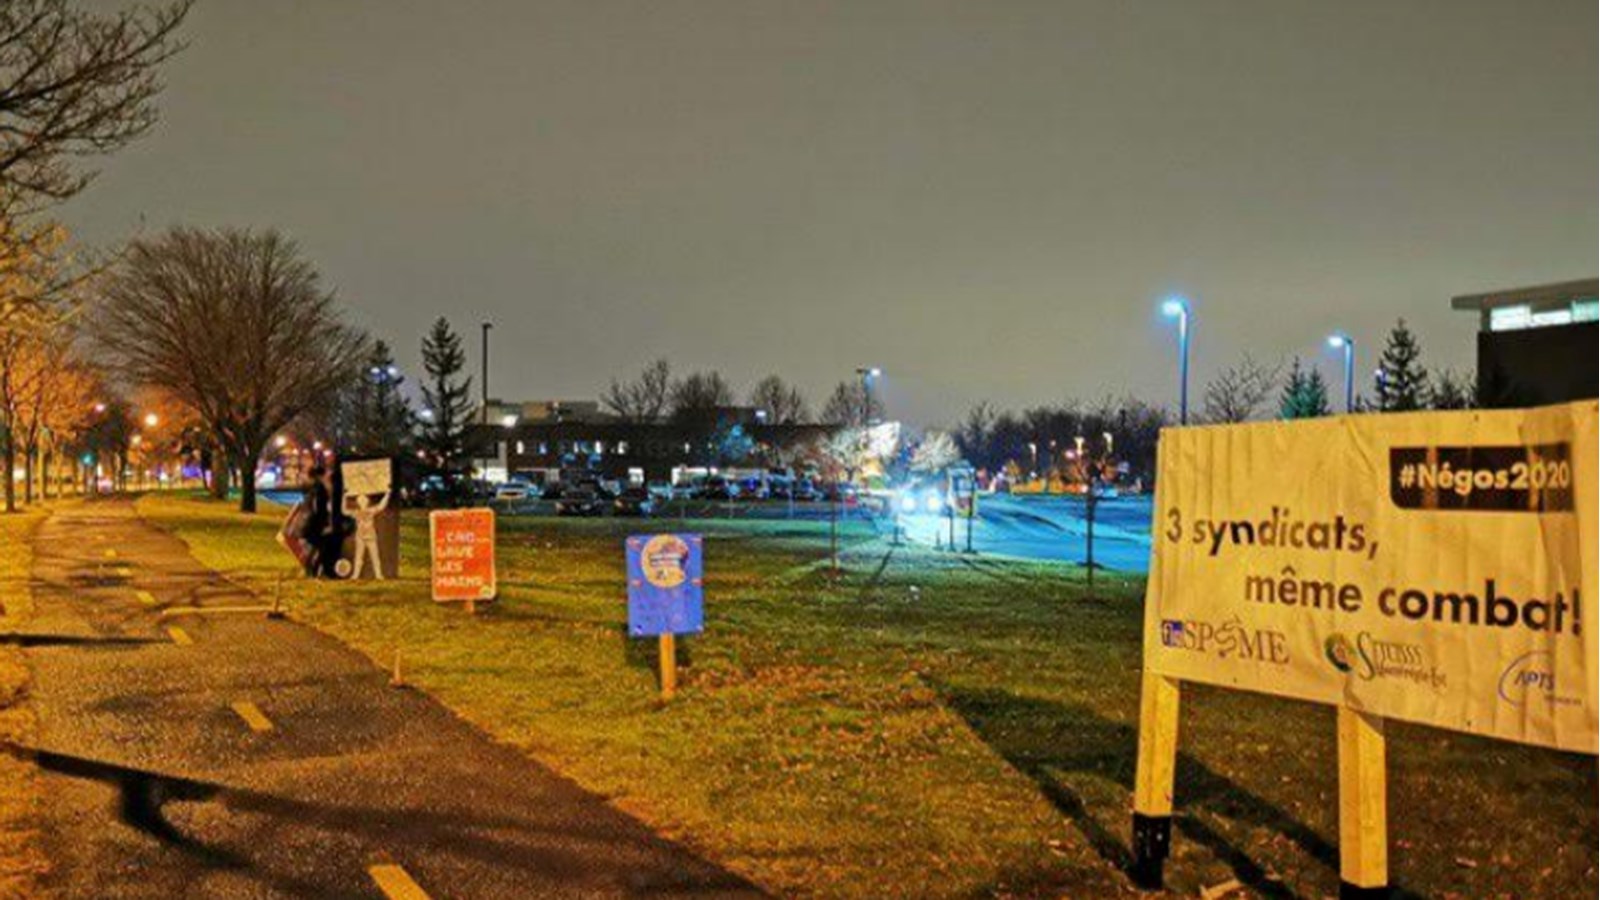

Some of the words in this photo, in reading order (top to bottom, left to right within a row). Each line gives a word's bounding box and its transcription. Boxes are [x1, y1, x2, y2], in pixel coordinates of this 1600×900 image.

[1399, 458, 1570, 496] #Négos2020
[1166, 507, 1183, 544] 3
[1192, 506, 1379, 560] syndicats,
[1244, 565, 1363, 612] même
[1378, 579, 1583, 636] combat!
